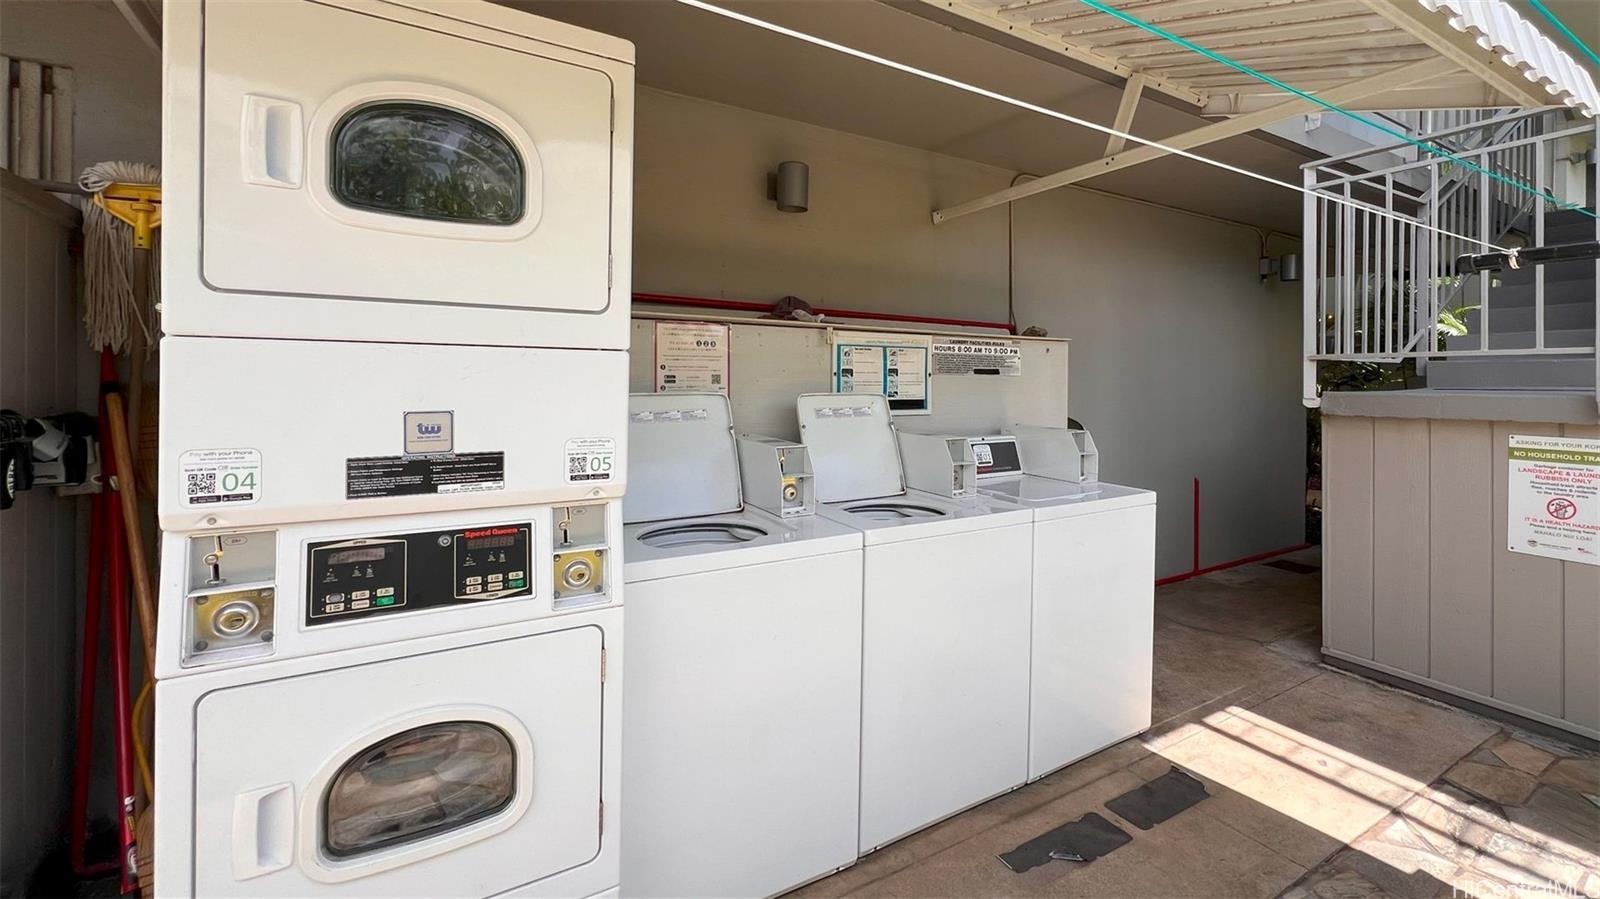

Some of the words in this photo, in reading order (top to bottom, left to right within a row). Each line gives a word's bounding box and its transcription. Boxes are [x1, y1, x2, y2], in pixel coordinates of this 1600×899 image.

[1527, 451, 1581, 461] HOUSEHOLD
[590, 456, 612, 472] 05
[1518, 467, 1564, 476] LANDSCAPE
[222, 472, 257, 492] 04
[1535, 474, 1570, 482] RUBBISH
[1571, 477, 1592, 485] ONLY
[465, 529, 491, 538] Speed
[492, 527, 518, 536] Queen
[1534, 529, 1562, 537] MAHALO
